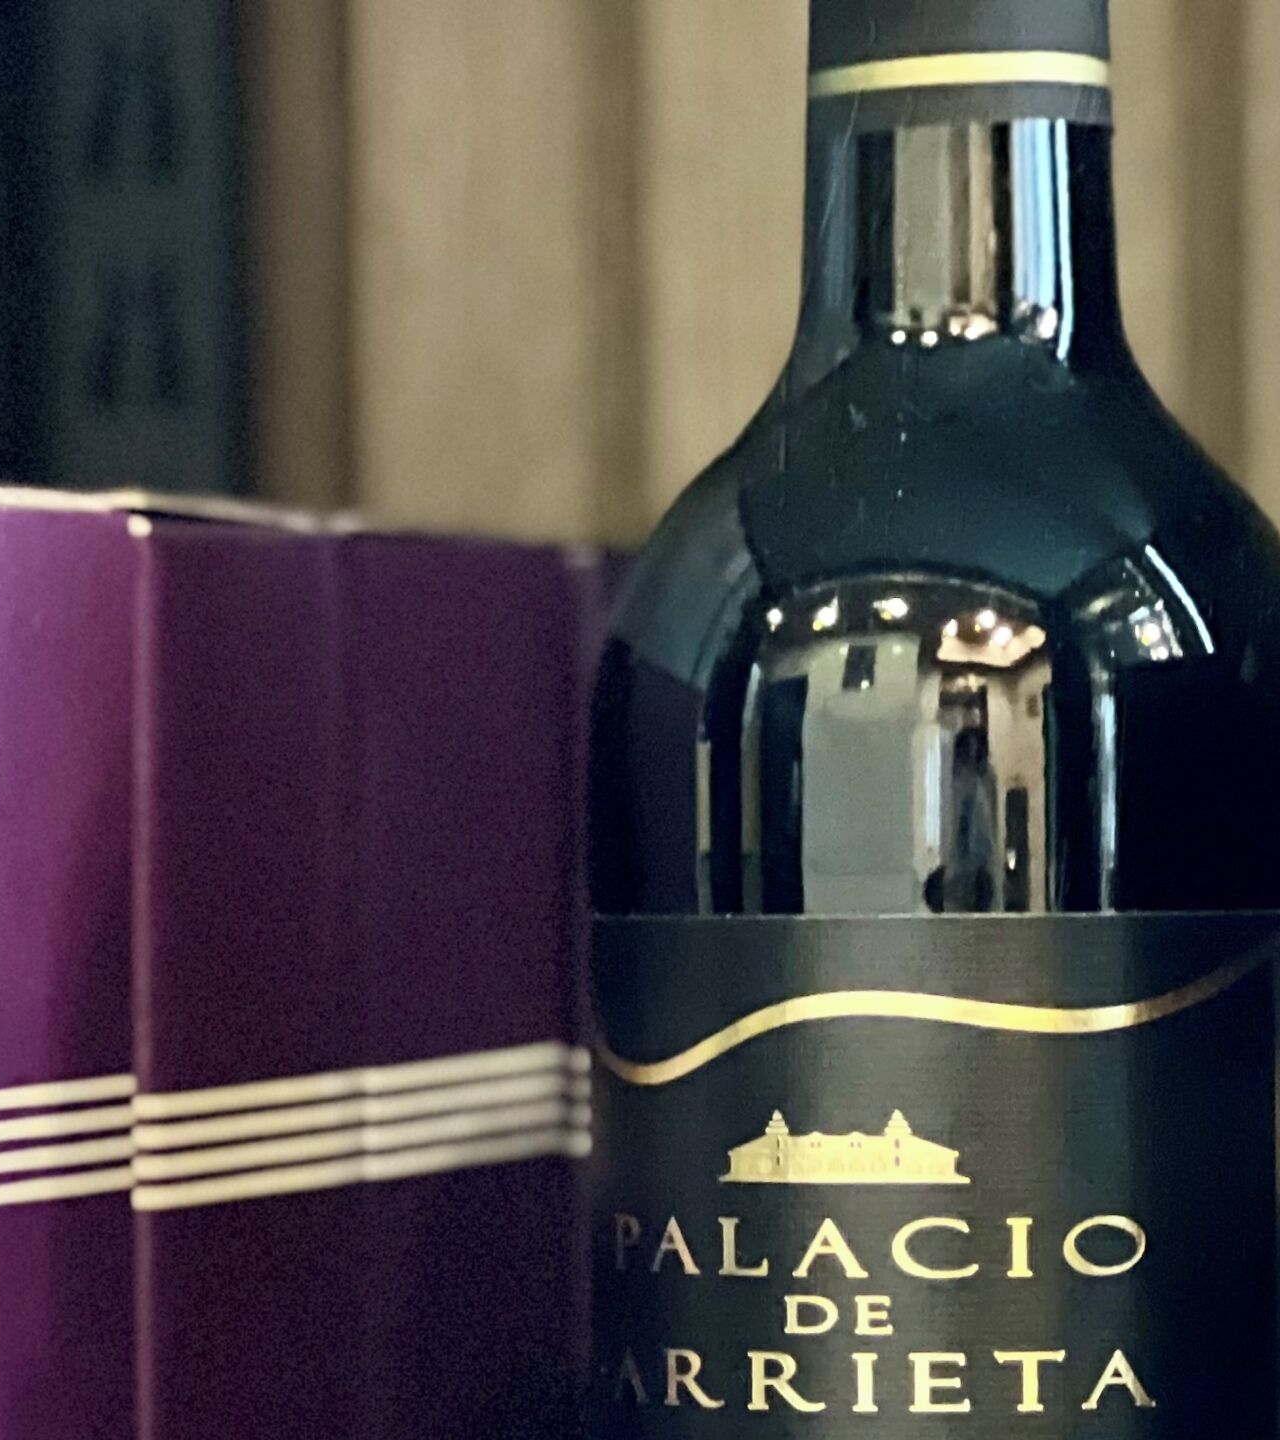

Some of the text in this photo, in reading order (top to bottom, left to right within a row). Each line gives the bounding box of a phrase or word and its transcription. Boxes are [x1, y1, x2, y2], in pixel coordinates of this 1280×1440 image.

[614, 1213, 1147, 1280] PALACIO
[783, 1294, 894, 1336] DE
[620, 1348, 1157, 1414] ARRIETA
